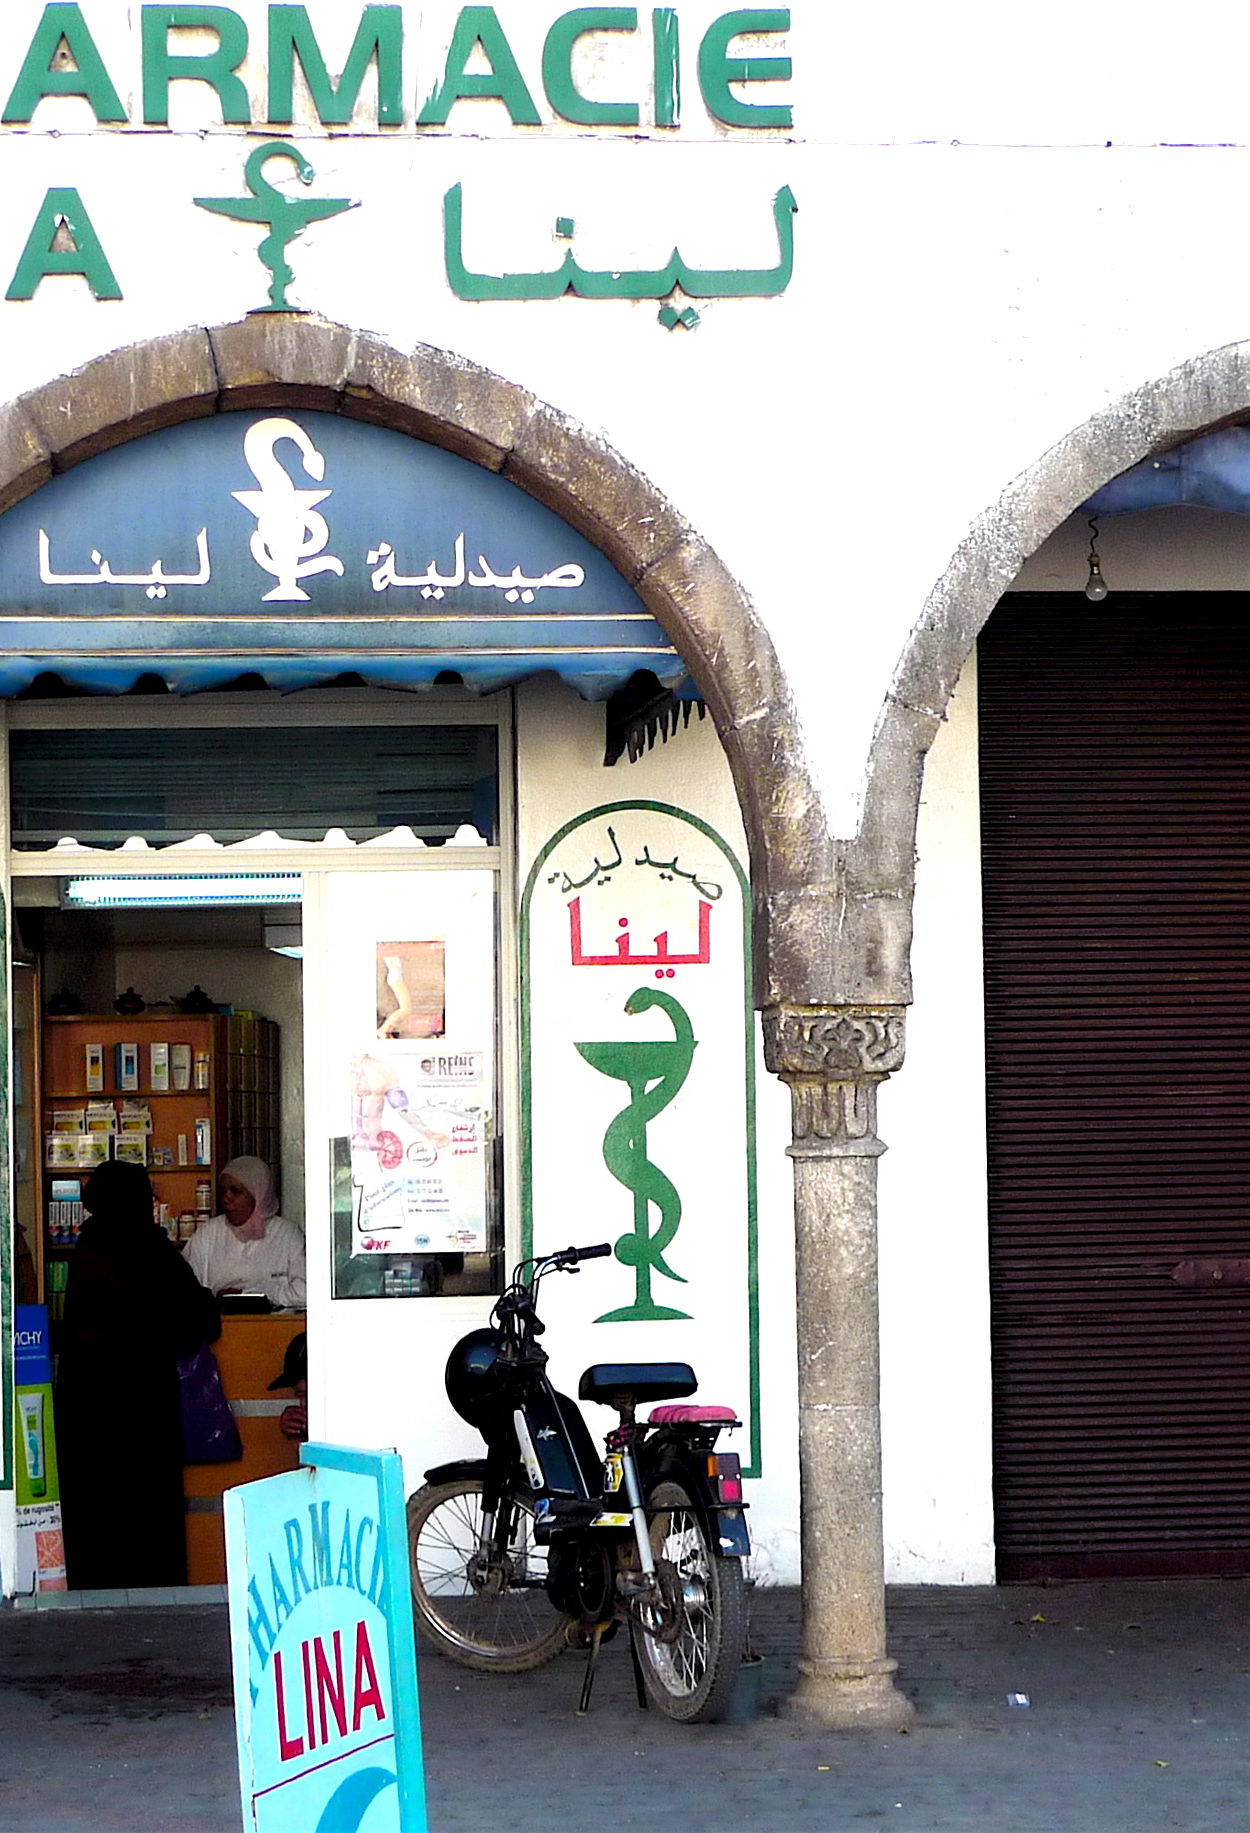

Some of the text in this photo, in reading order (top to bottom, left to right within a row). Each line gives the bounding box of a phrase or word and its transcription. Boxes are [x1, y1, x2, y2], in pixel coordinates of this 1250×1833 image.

[443, 181, 798, 330] لينا
[38, 528, 585, 605] صيدلية لينا
[547, 826, 724, 901] صيدلية
[567, 895, 713, 979] لينا
[247, 1500, 388, 1707] HARMACI
[273, 1620, 387, 1762] LINA
